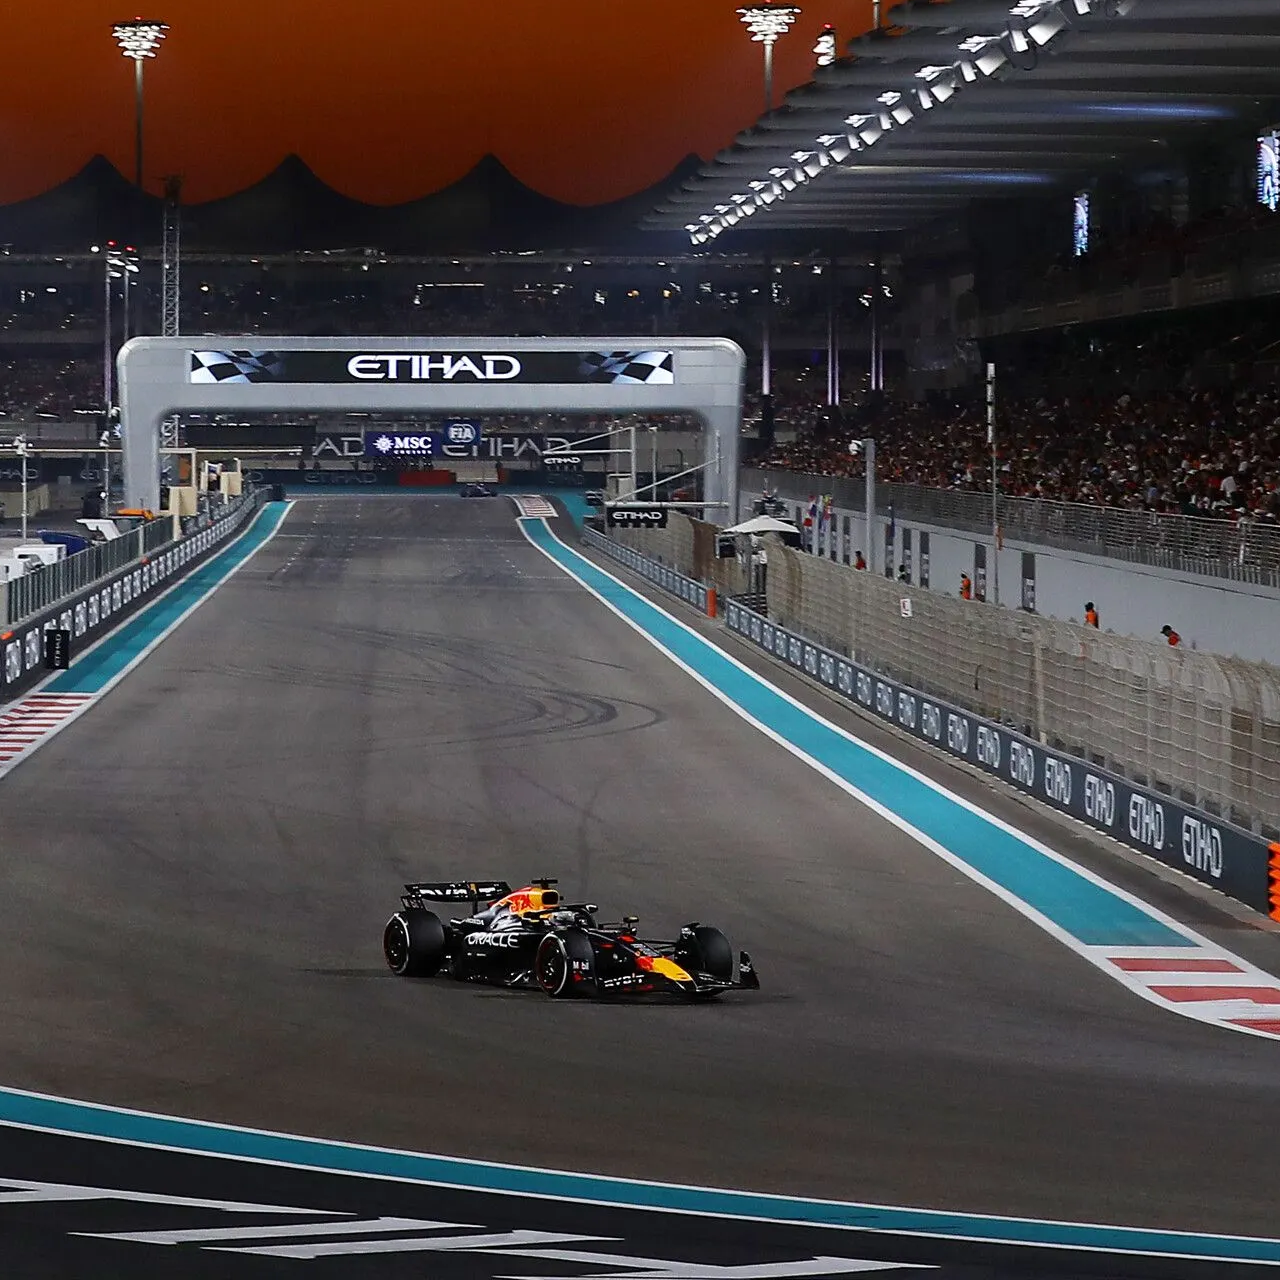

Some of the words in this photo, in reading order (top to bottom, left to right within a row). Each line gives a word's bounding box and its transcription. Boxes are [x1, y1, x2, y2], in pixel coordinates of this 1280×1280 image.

[347, 354, 520, 379] ETIHAD
[393, 436, 432, 449] MSC
[449, 427, 474, 440] FIA
[612, 510, 662, 520] ETIHAD
[1045, 756, 1072, 805] ETIHAD
[1085, 773, 1115, 827] ETIHAD
[1129, 793, 1164, 850] ETIHAD
[1182, 815, 1222, 878] ETIHAD
[467, 931, 520, 949] ORACLE
